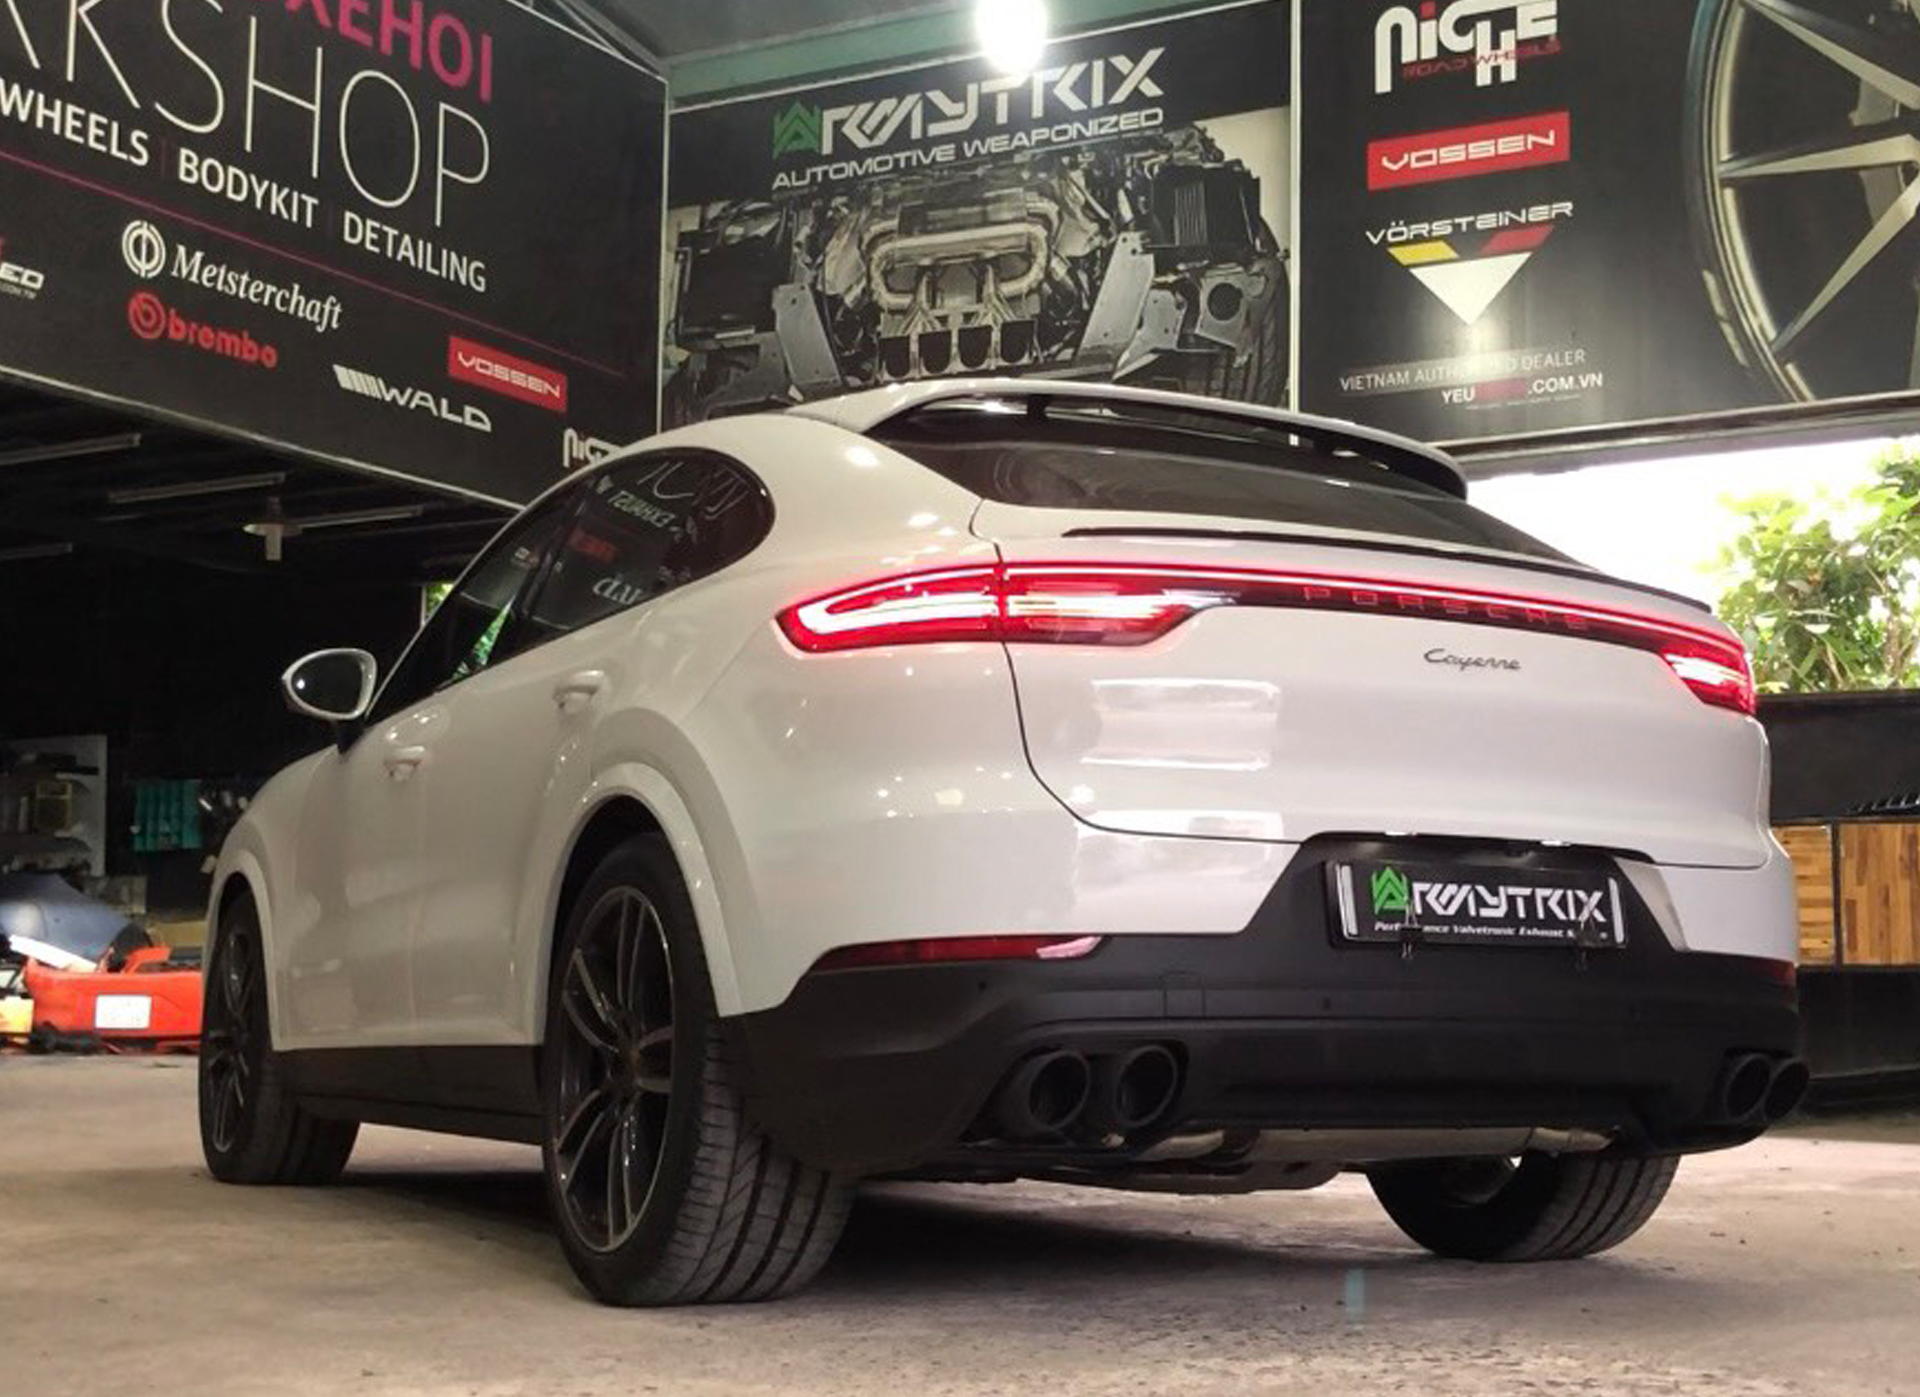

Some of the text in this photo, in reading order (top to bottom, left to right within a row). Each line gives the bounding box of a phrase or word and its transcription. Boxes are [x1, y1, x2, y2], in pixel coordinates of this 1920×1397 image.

[284, 0, 493, 103] EHOI
[8, 0, 490, 228] KSHOP
[771, 107, 1164, 190] AUTOMOTIVE WEAPONIZED
[1382, 129, 1555, 171] VOSSEN
[0, 78, 486, 292] WHEELS BODYKIT DETAILING
[1366, 201, 1574, 244] VÖRSTEINER
[171, 244, 343, 333] Meisterchaft
[168, 307, 278, 369] brembo
[457, 350, 561, 399] VOSSEN
[1339, 370, 1410, 391] VIETNAM
[1521, 348, 1586, 371] DEALER
[376, 377, 492, 432] WALD
[1303, 586, 1589, 630] PORSCHE
[1423, 648, 1521, 672] Cayenne
